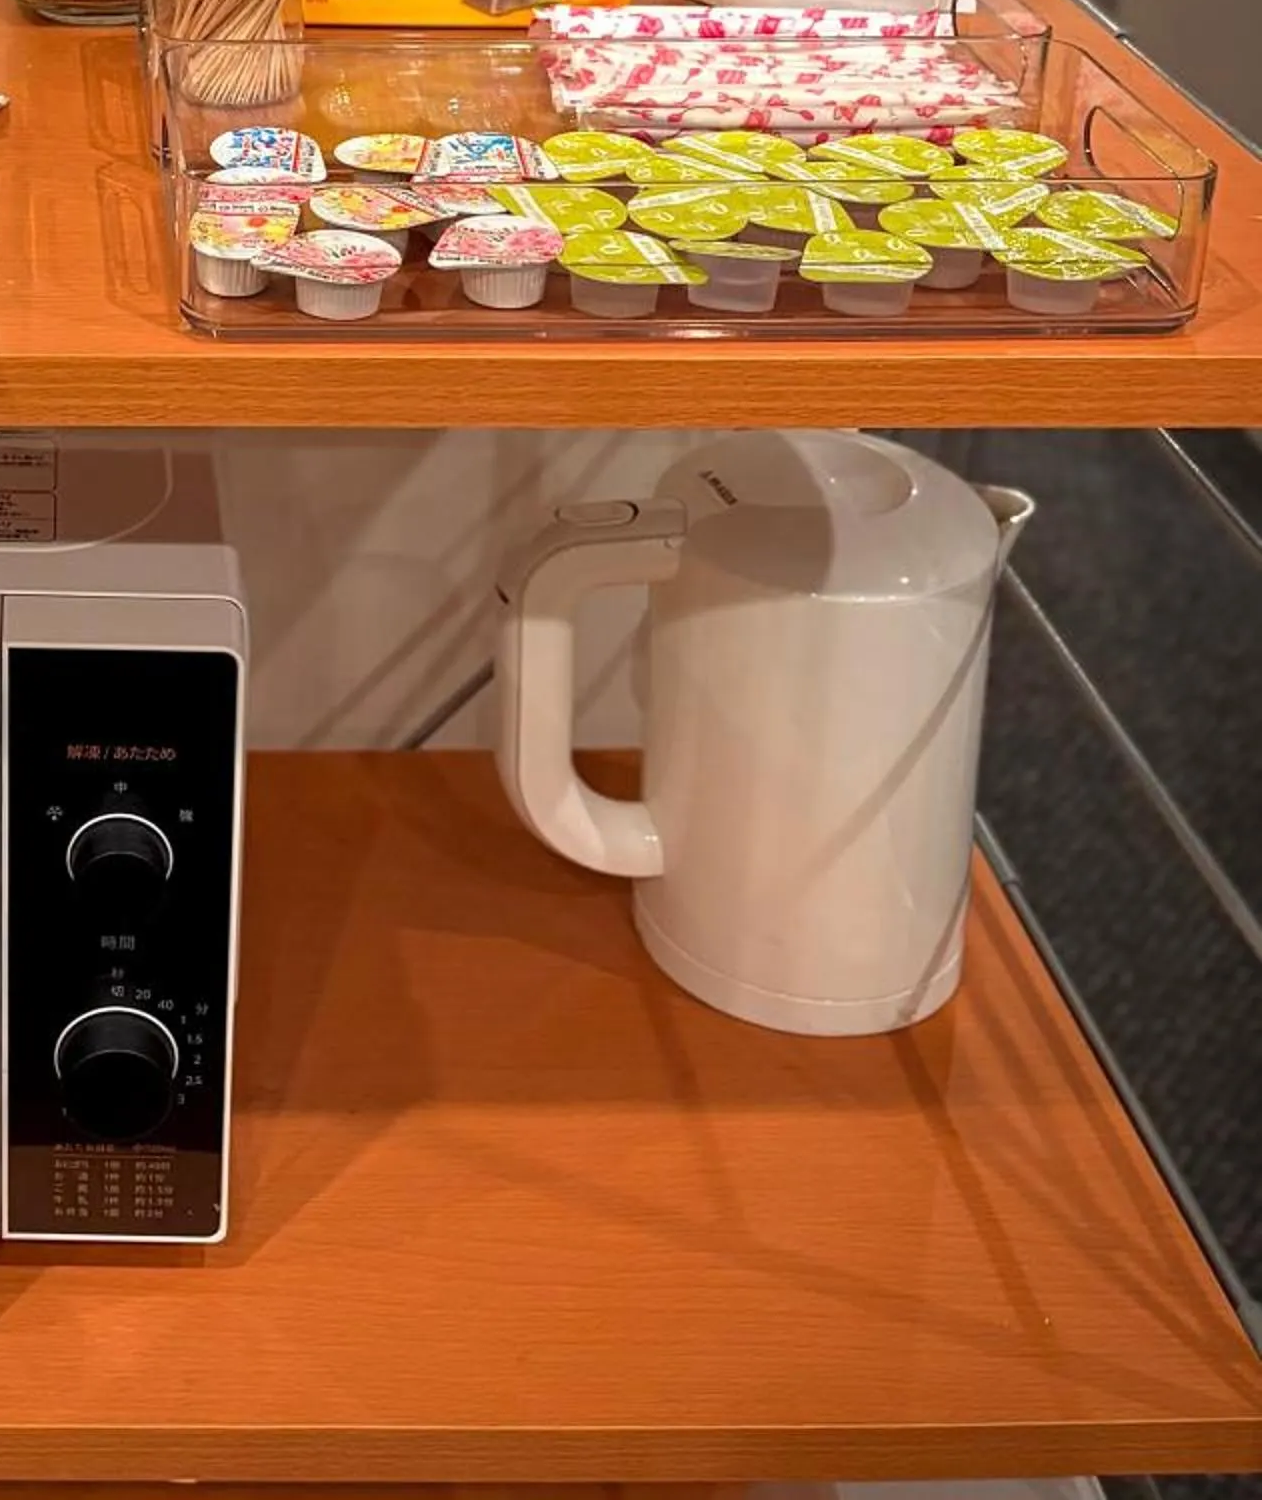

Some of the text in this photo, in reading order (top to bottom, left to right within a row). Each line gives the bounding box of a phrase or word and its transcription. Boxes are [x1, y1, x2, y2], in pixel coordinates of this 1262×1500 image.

[113, 745, 177, 761] あたため
[113, 781, 128, 795] 中
[100, 935, 136, 950] 時間
[135, 988, 152, 1000] 20
[157, 999, 175, 1011] 40
[193, 1053, 202, 1065] 2
